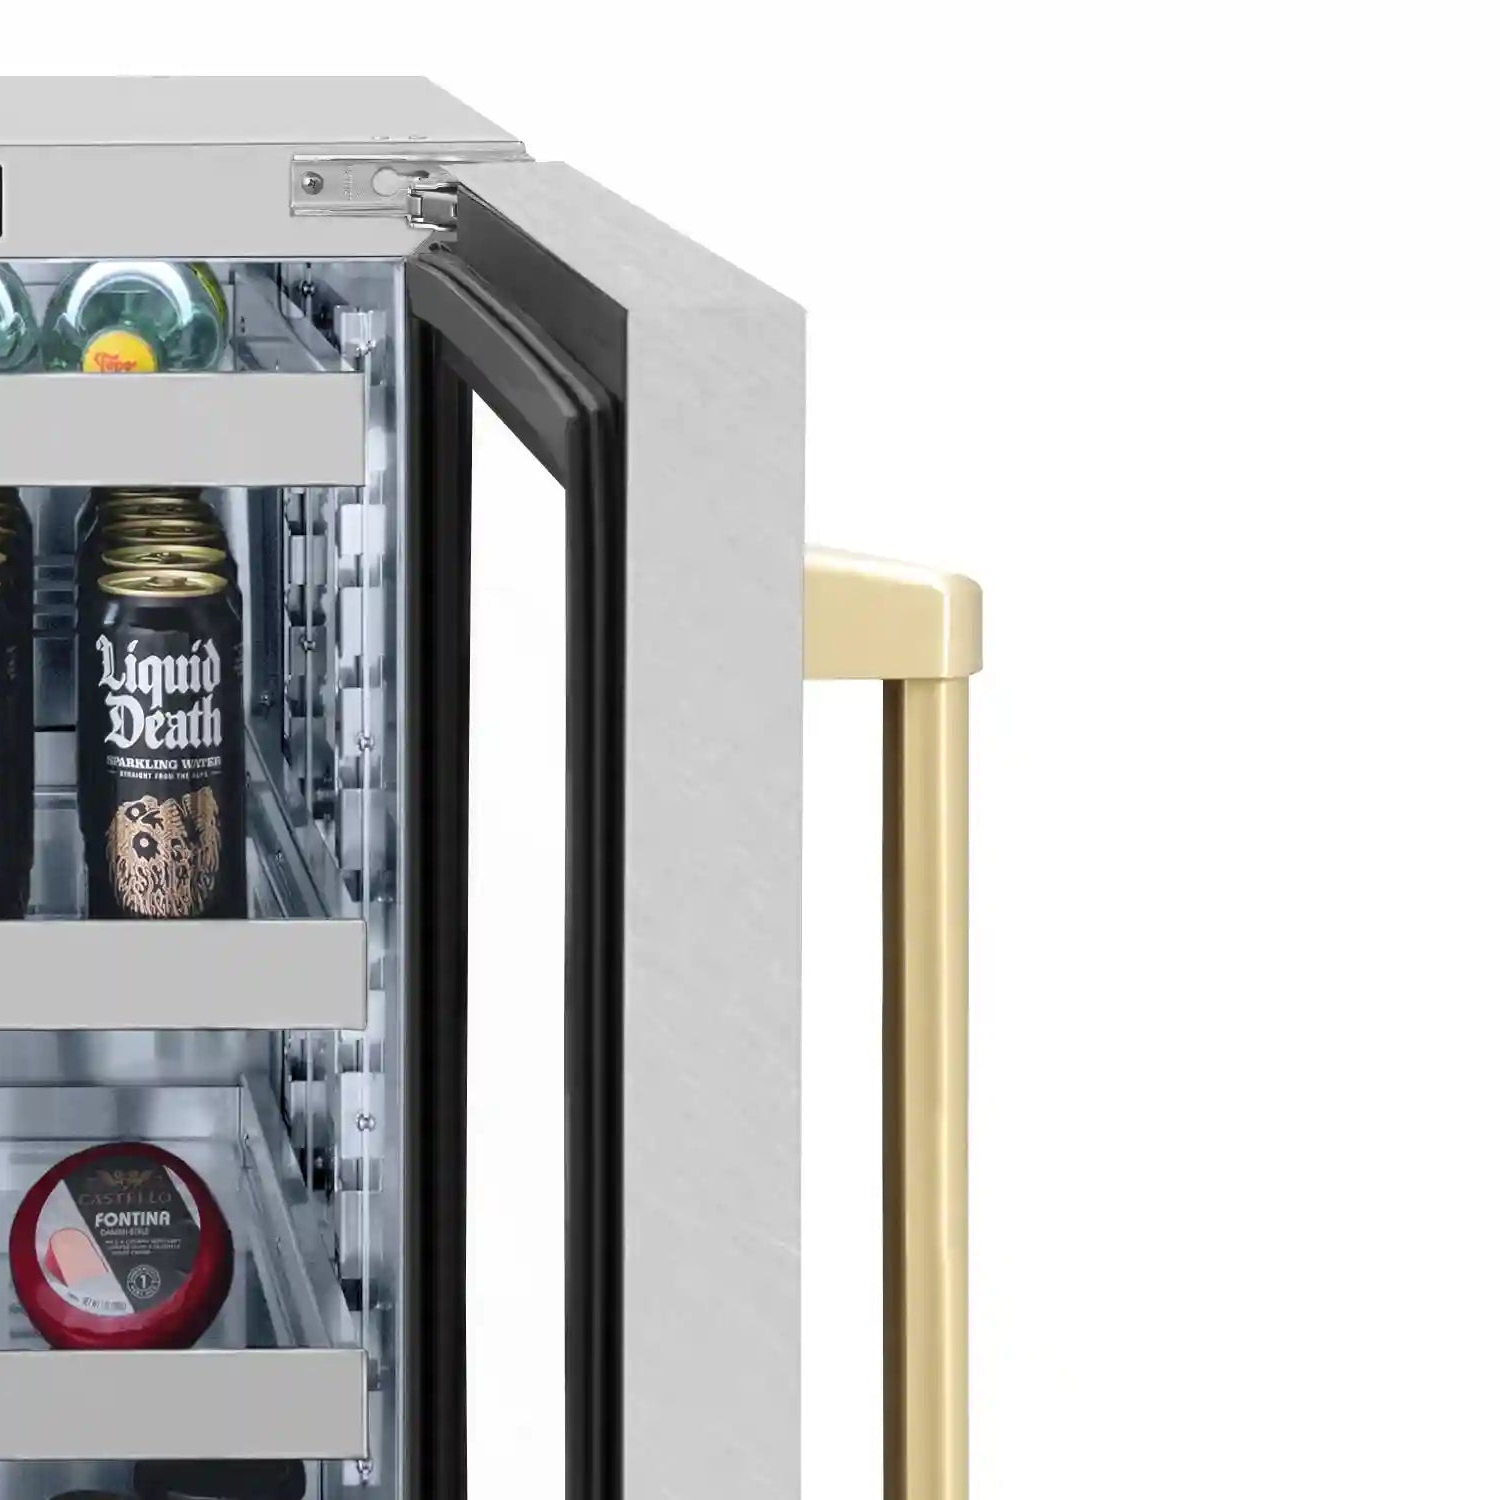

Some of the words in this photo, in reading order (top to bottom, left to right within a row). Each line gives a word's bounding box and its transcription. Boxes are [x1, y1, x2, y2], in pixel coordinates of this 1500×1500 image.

[96, 634, 221, 710] Liquid
[104, 691, 223, 750] Death
[106, 755, 178, 770] SPARKLING
[181, 755, 222, 769] WATER
[120, 770, 152, 779] STRAIGHT
[154, 772, 174, 780] FROM
[95, 1211, 171, 1228] FONTINA
